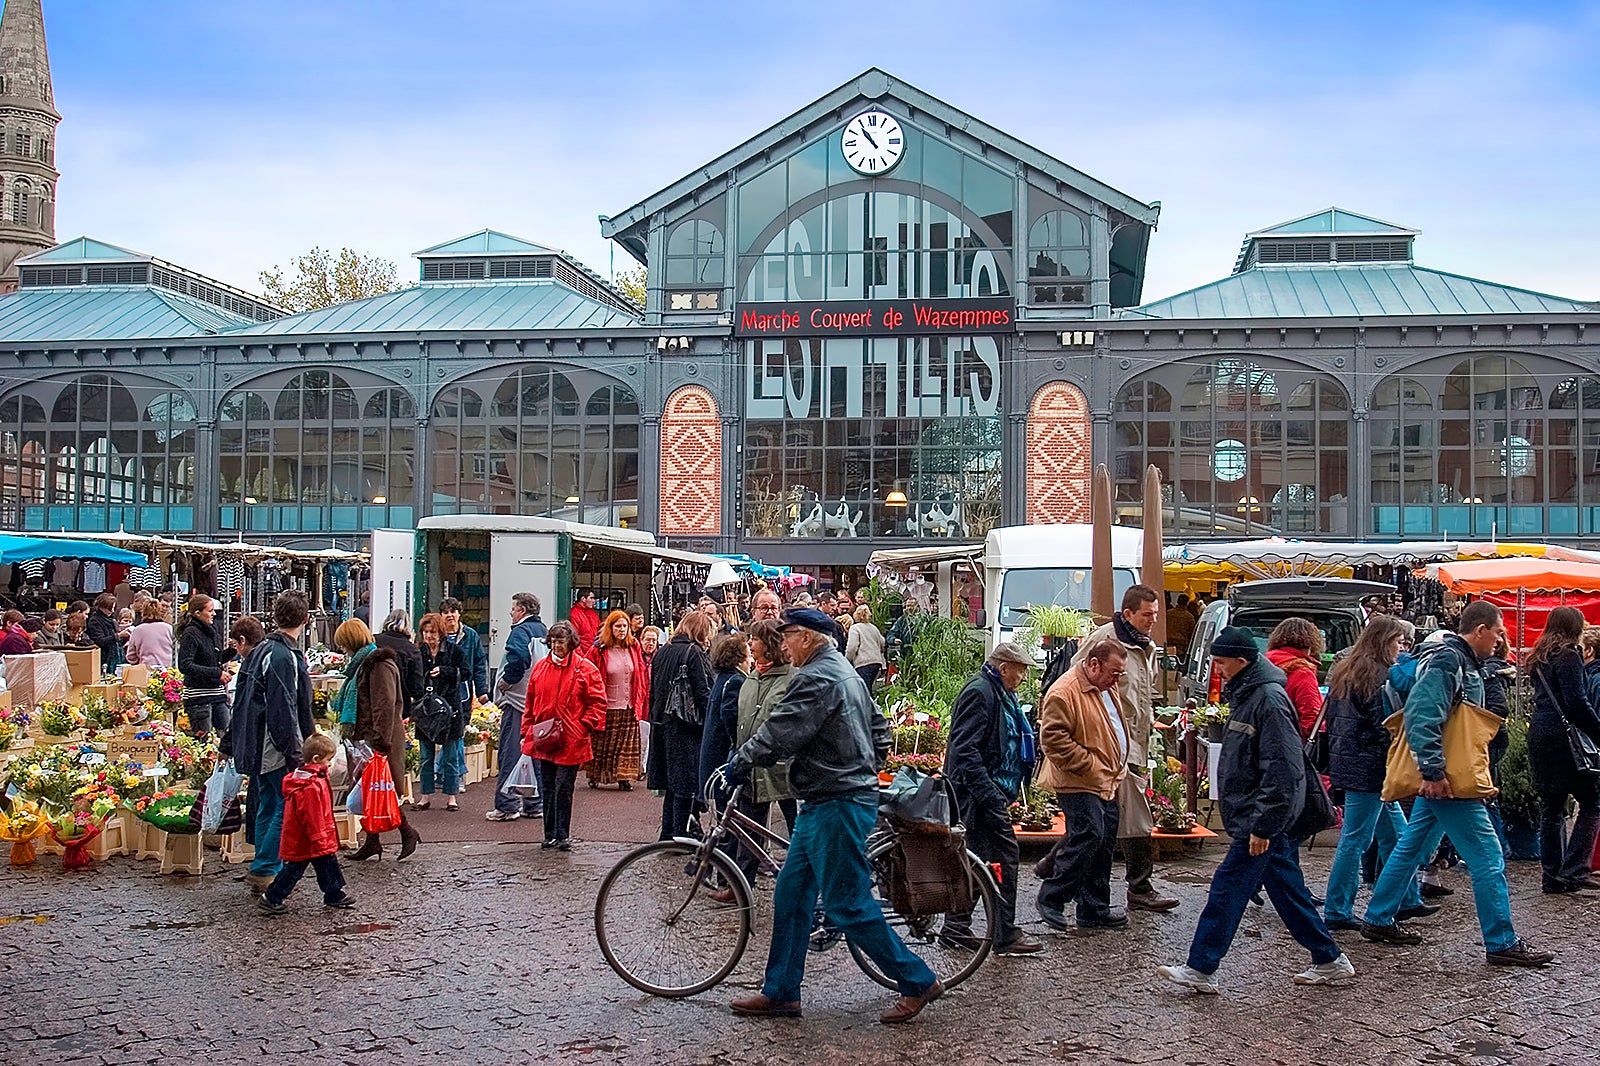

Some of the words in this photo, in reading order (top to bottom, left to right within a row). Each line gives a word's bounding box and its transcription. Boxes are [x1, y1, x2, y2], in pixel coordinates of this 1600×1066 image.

[741, 310, 800, 333] Marché
[811, 308, 873, 330] Couvert
[883, 309, 903, 330] de
[913, 303, 1009, 329] Wazemmes
